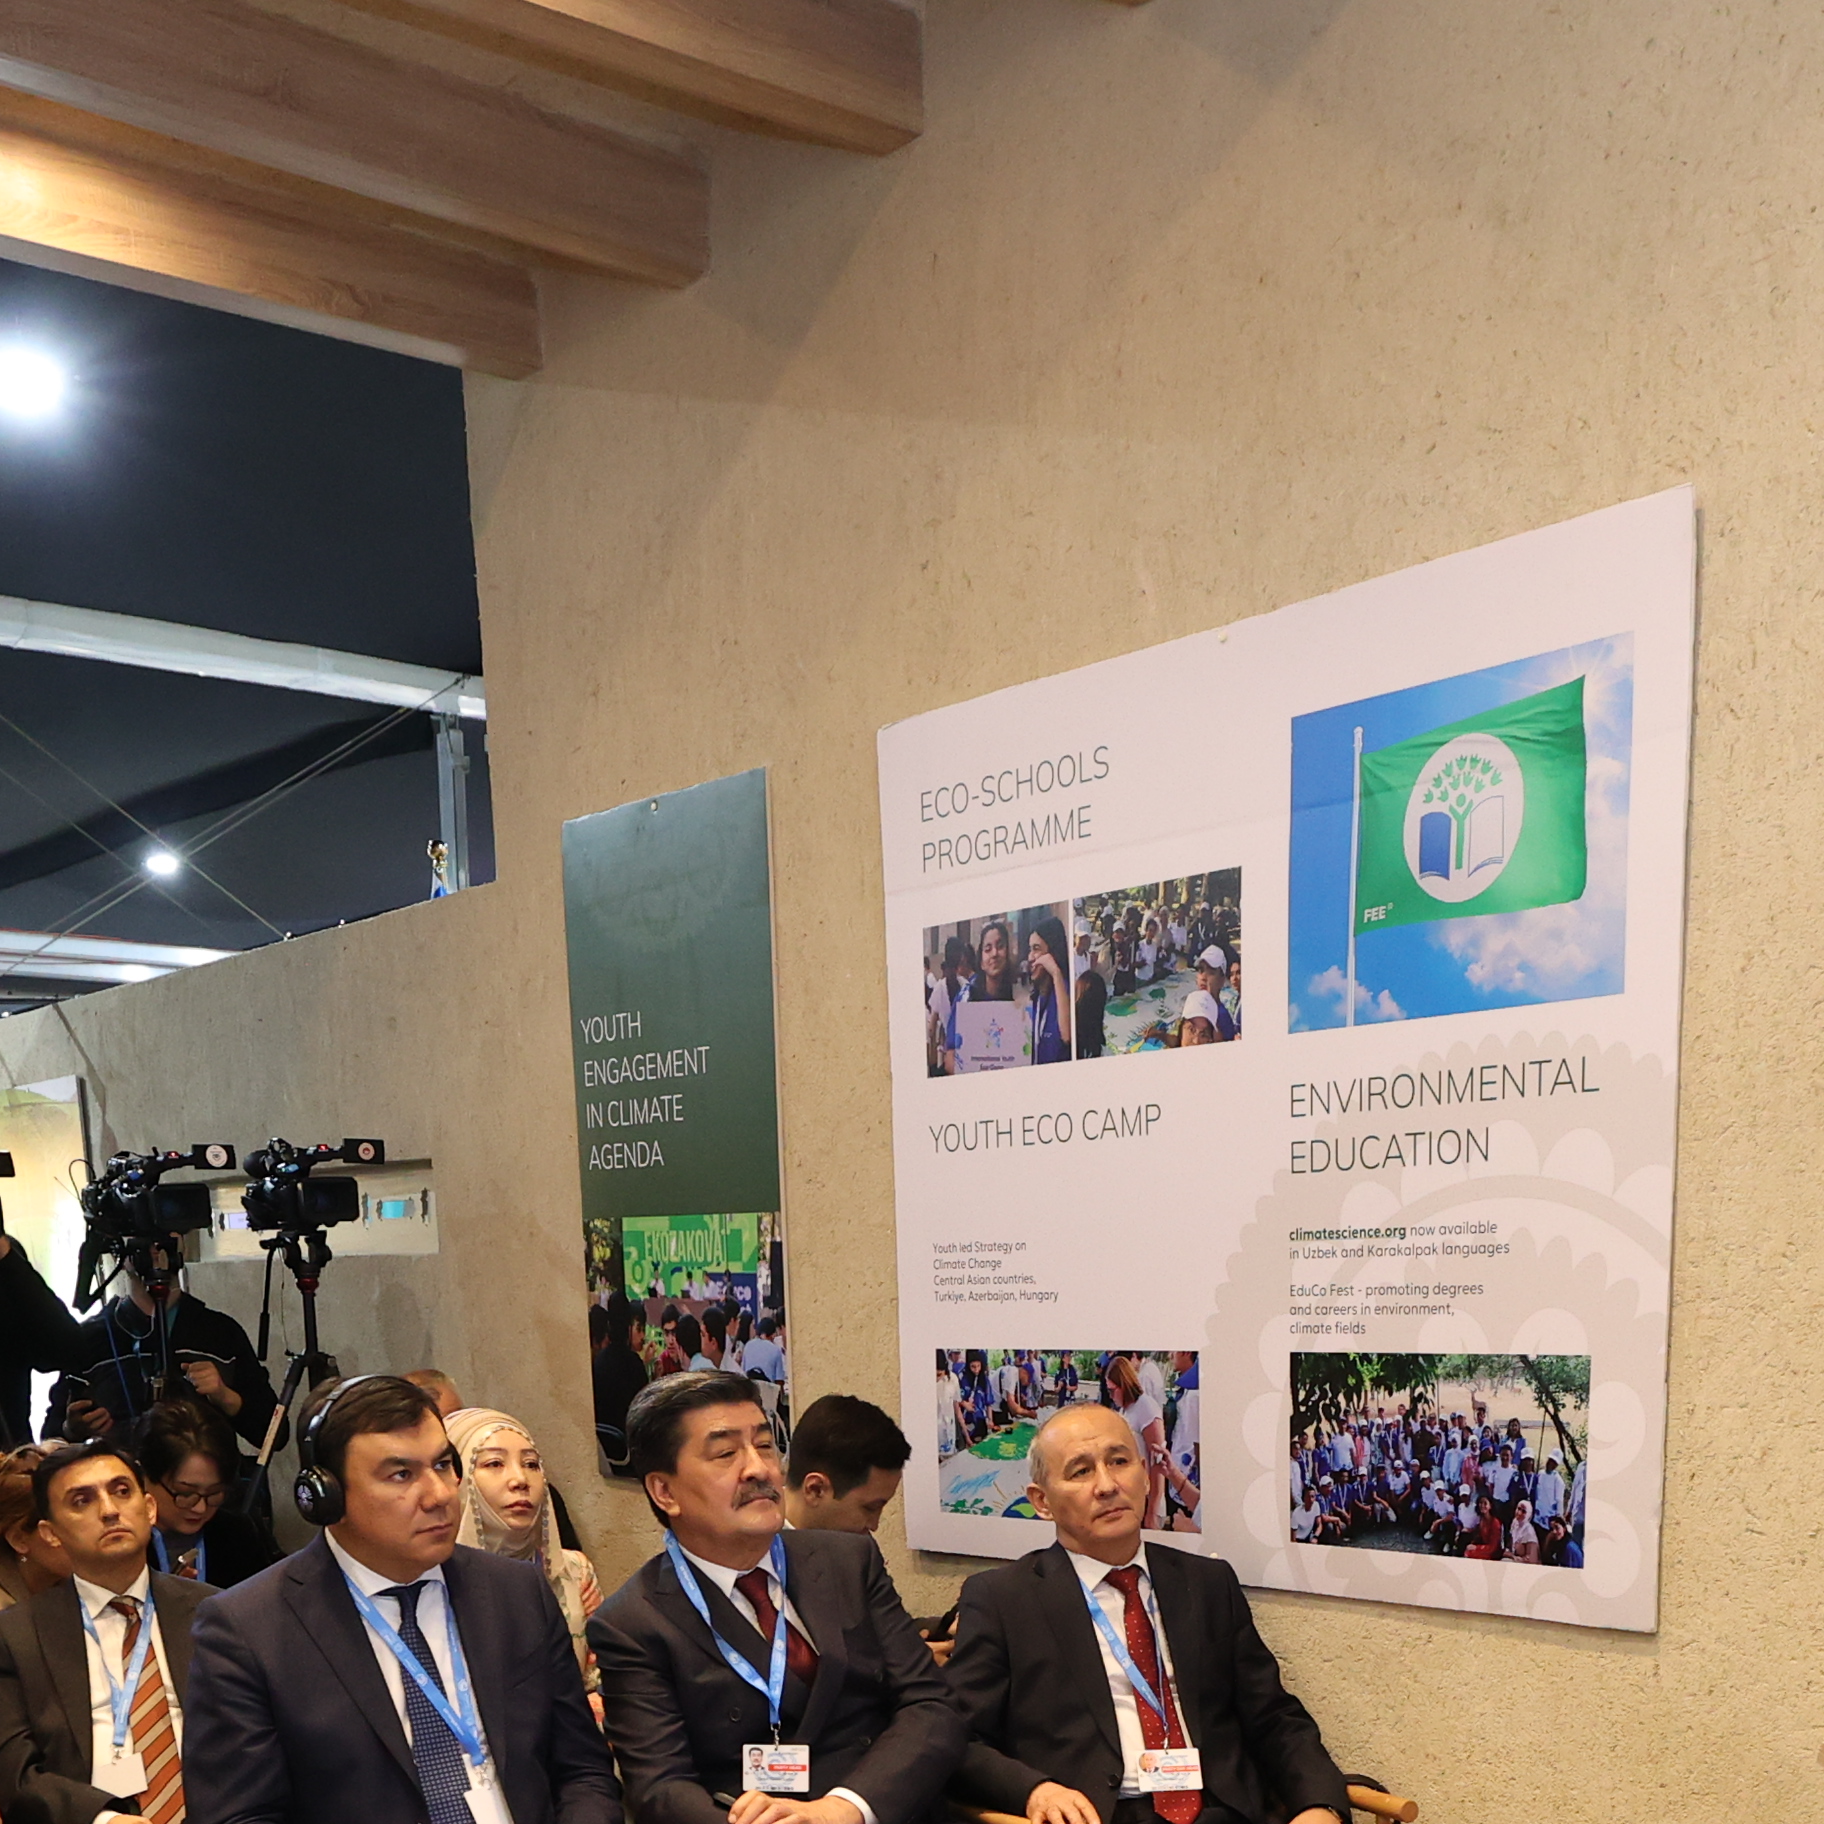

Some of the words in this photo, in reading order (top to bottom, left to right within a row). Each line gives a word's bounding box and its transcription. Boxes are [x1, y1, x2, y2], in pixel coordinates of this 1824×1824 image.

[920, 745, 1110, 822] ECO-SCHOOLS
[922, 804, 1092, 873] PROGRAMME
[580, 1010, 642, 1044] YOUTH
[583, 1046, 711, 1087] ENGAGEMENT
[1290, 1055, 1601, 1118] ENVIRONMENTAL
[586, 1103, 604, 1129] IN
[607, 1094, 684, 1127] CLIMATE
[929, 1117, 1013, 1153] YOUTH
[1022, 1111, 1073, 1147] ECO
[1082, 1103, 1162, 1141] CAMP
[589, 1140, 665, 1170] AGENDA
[1291, 1127, 1490, 1174] EDUCATION
[1289, 1226, 1407, 1241] climatescience.org
[1410, 1225, 1435, 1237] now
[1438, 1221, 1498, 1236] available
[933, 1242, 957, 1254] Youth
[959, 1242, 973, 1253] led
[974, 1241, 1013, 1255] Strategy
[1015, 1242, 1026, 1251] on
[1289, 1248, 1299, 1259] in
[1302, 1245, 1338, 1259] Uzbek
[1341, 1245, 1364, 1258] and
[1367, 1243, 1439, 1259] Karakalpak
[1442, 1242, 1510, 1258] languages
[933, 1258, 966, 1270] Climate
[968, 1257, 1002, 1271] Change
[933, 1274, 965, 1286] Central
[967, 1274, 991, 1285] Asian
[1289, 1284, 1327, 1297] EduCo
[1329, 1283, 1355, 1297] Fest
[1365, 1283, 1429, 1299] promoting
[1432, 1282, 1484, 1298] degrees
[1019, 1290, 1059, 1303] Hungary
[1289, 1303, 1312, 1316] and
[1314, 1304, 1358, 1315] careers
[1360, 1303, 1371, 1315] in
[1374, 1302, 1455, 1317] environment,
[1289, 1321, 1332, 1335] climate
[1335, 1321, 1366, 1335] fields
